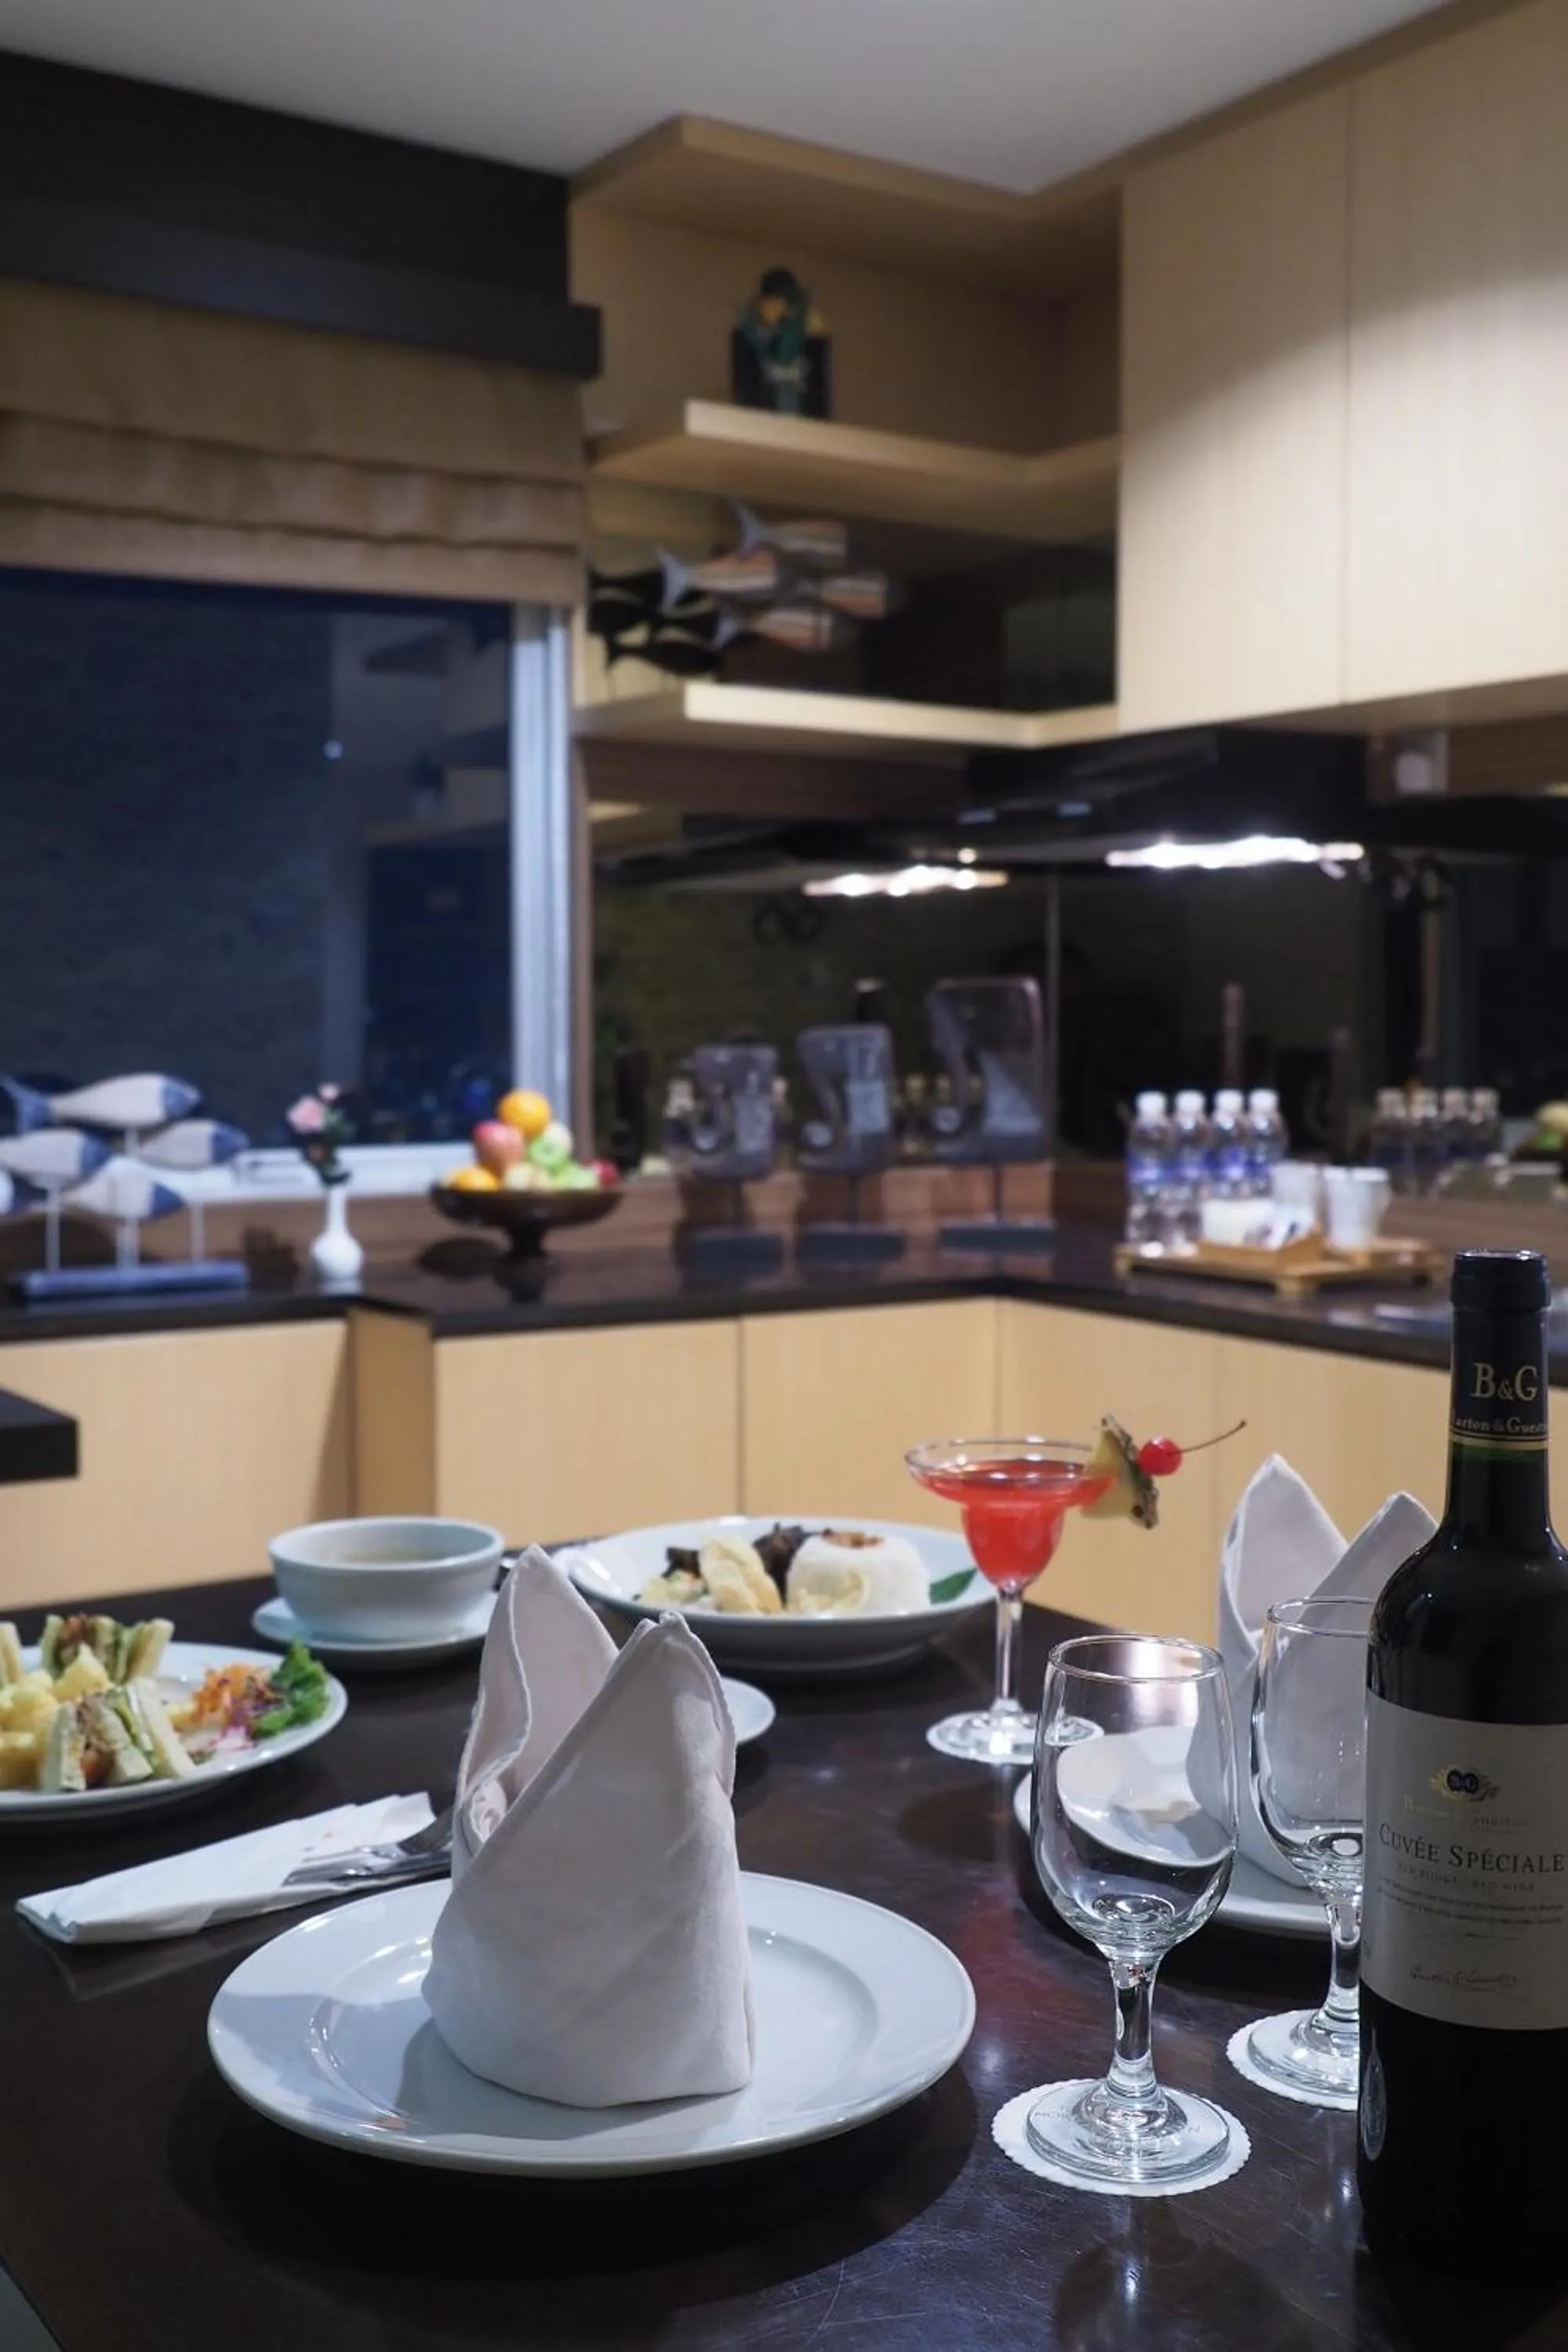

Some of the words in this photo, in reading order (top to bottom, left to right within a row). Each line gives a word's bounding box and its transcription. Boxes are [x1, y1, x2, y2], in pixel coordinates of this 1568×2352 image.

[1470, 1363, 1539, 1401] B&G
[1379, 1823, 1440, 1863] CUVÉE
[1448, 1844, 1565, 1874] SPÉCIALE
